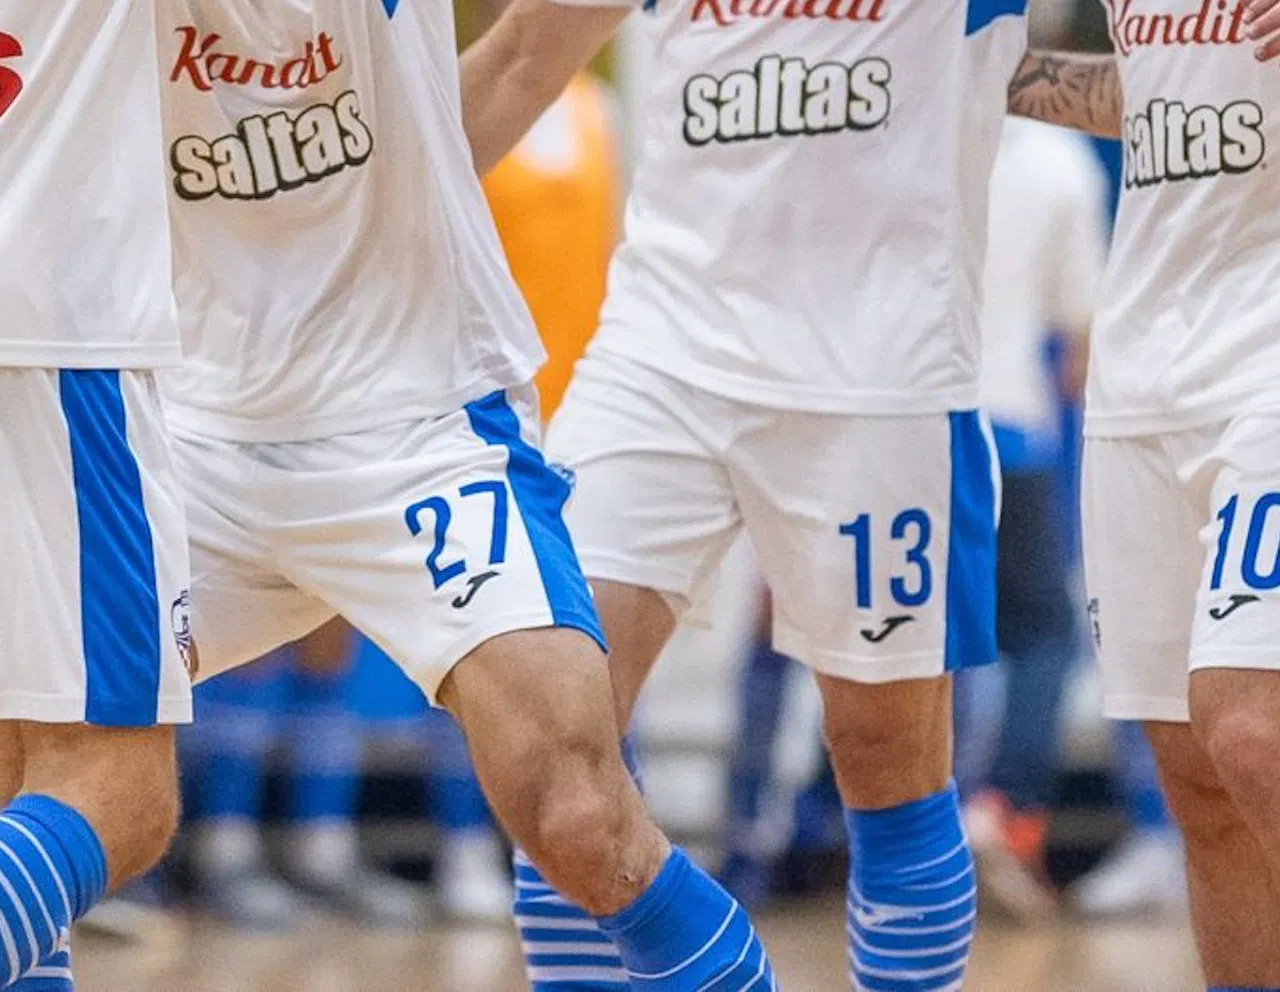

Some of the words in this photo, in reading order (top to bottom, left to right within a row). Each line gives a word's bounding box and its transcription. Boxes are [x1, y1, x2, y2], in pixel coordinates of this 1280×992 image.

[170, 89, 374, 201] saltas
[683, 54, 892, 146] saltas
[404, 479, 508, 591] 27
[838, 508, 932, 610] 13
